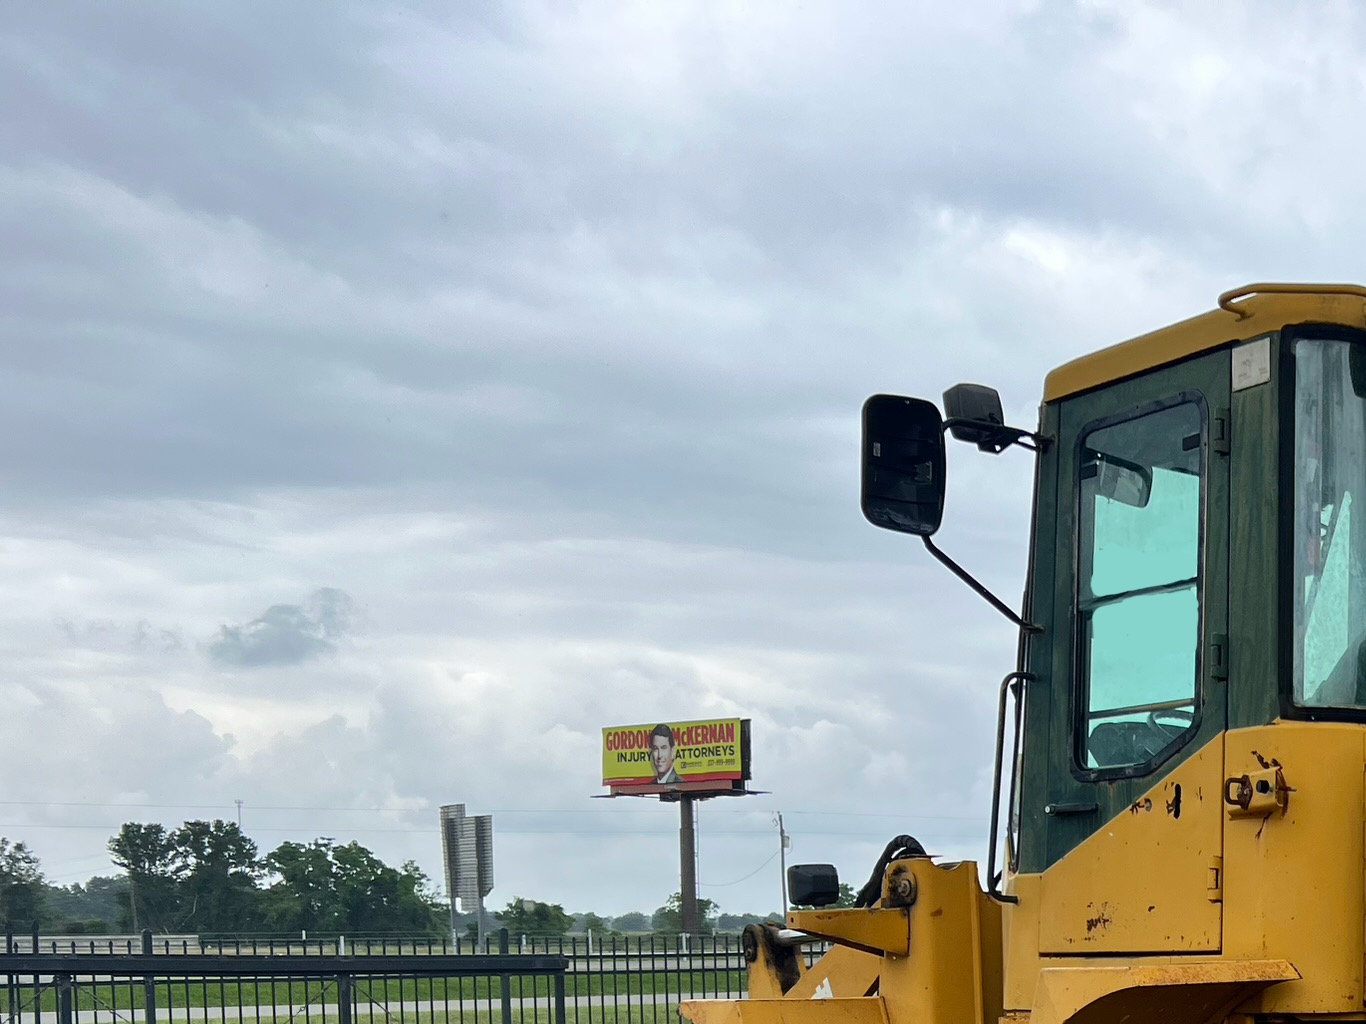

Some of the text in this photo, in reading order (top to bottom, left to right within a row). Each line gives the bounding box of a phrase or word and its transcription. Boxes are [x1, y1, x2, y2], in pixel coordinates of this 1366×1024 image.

[606, 723, 735, 751] GORDON McKERNAN
[617, 745, 735, 763] INJURY ATTORNEYS
